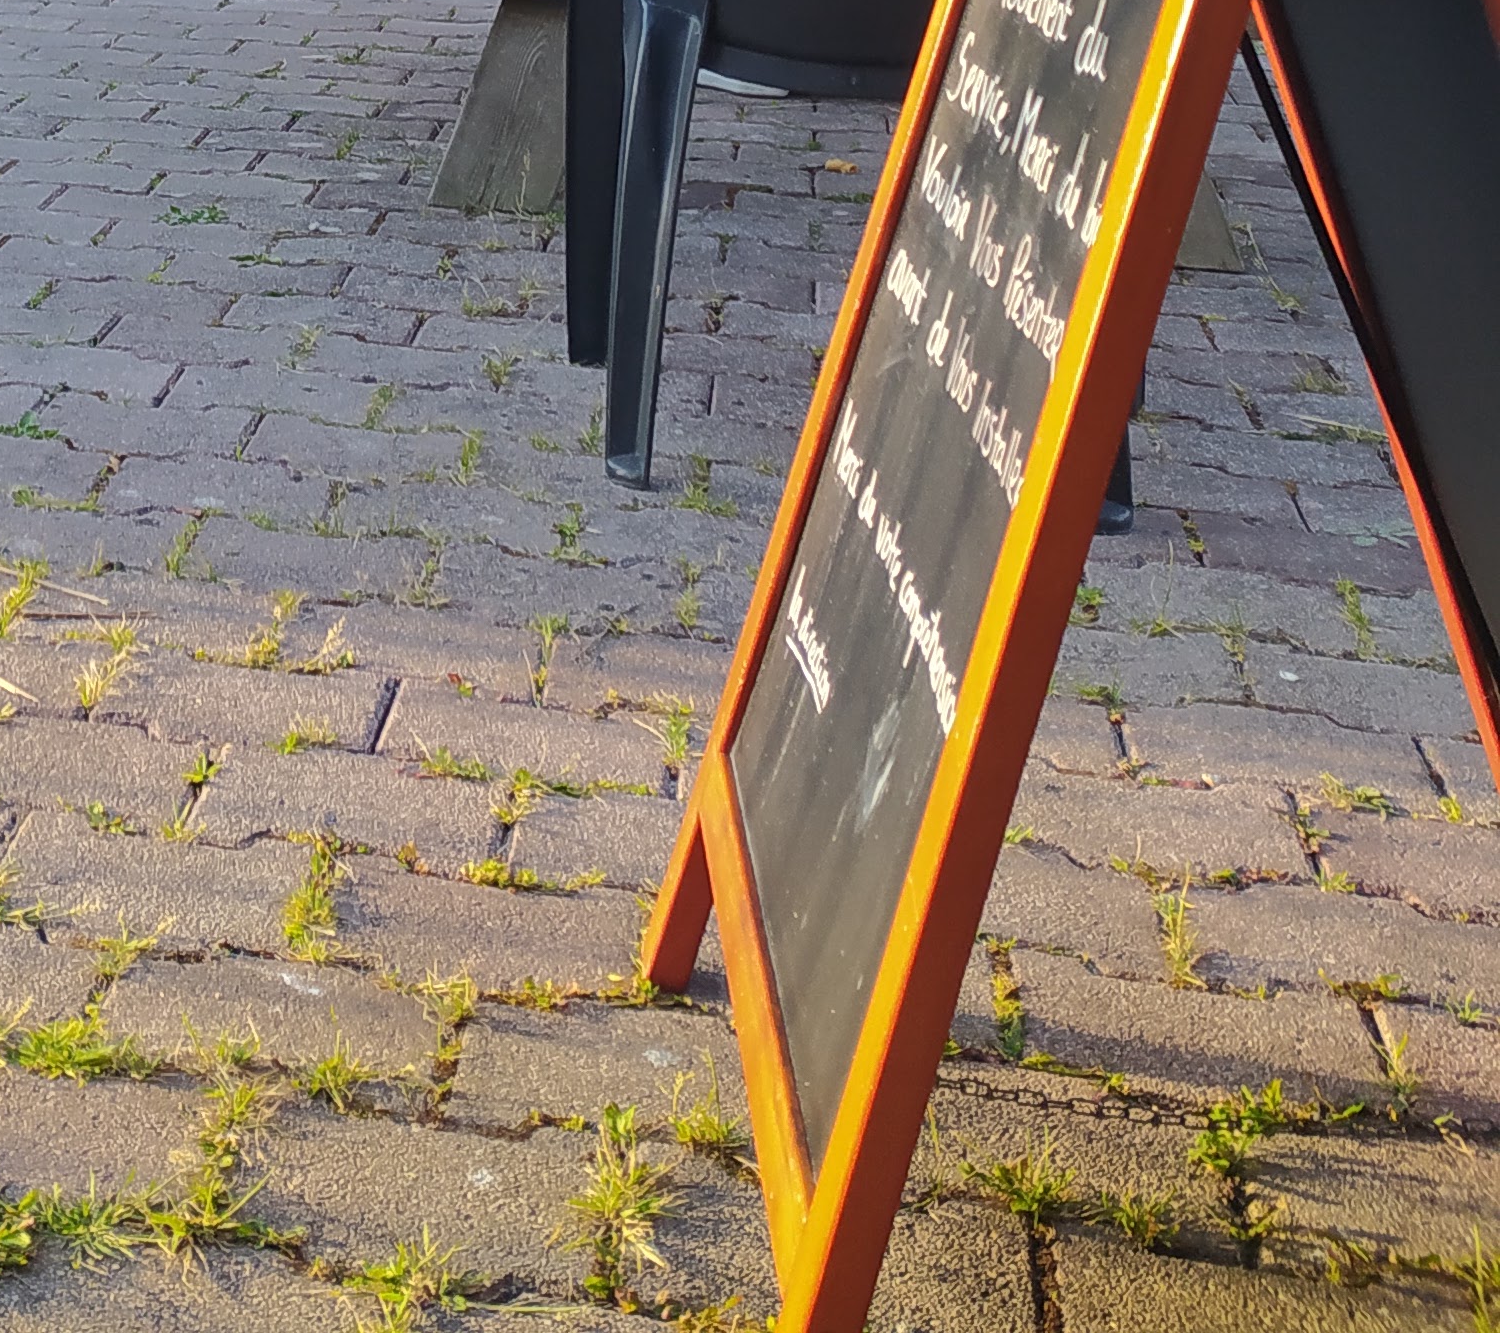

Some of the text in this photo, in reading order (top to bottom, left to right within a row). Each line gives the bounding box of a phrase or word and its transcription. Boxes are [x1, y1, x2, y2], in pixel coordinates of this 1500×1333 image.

[1055, 133, 1090, 230] de
[969, 194, 1005, 288] Vous
[887, 249, 931, 325] avant
[925, 290, 954, 367] de
[945, 316, 979, 412] Vous
[832, 398, 864, 500] Merci
[857, 468, 878, 529] de
